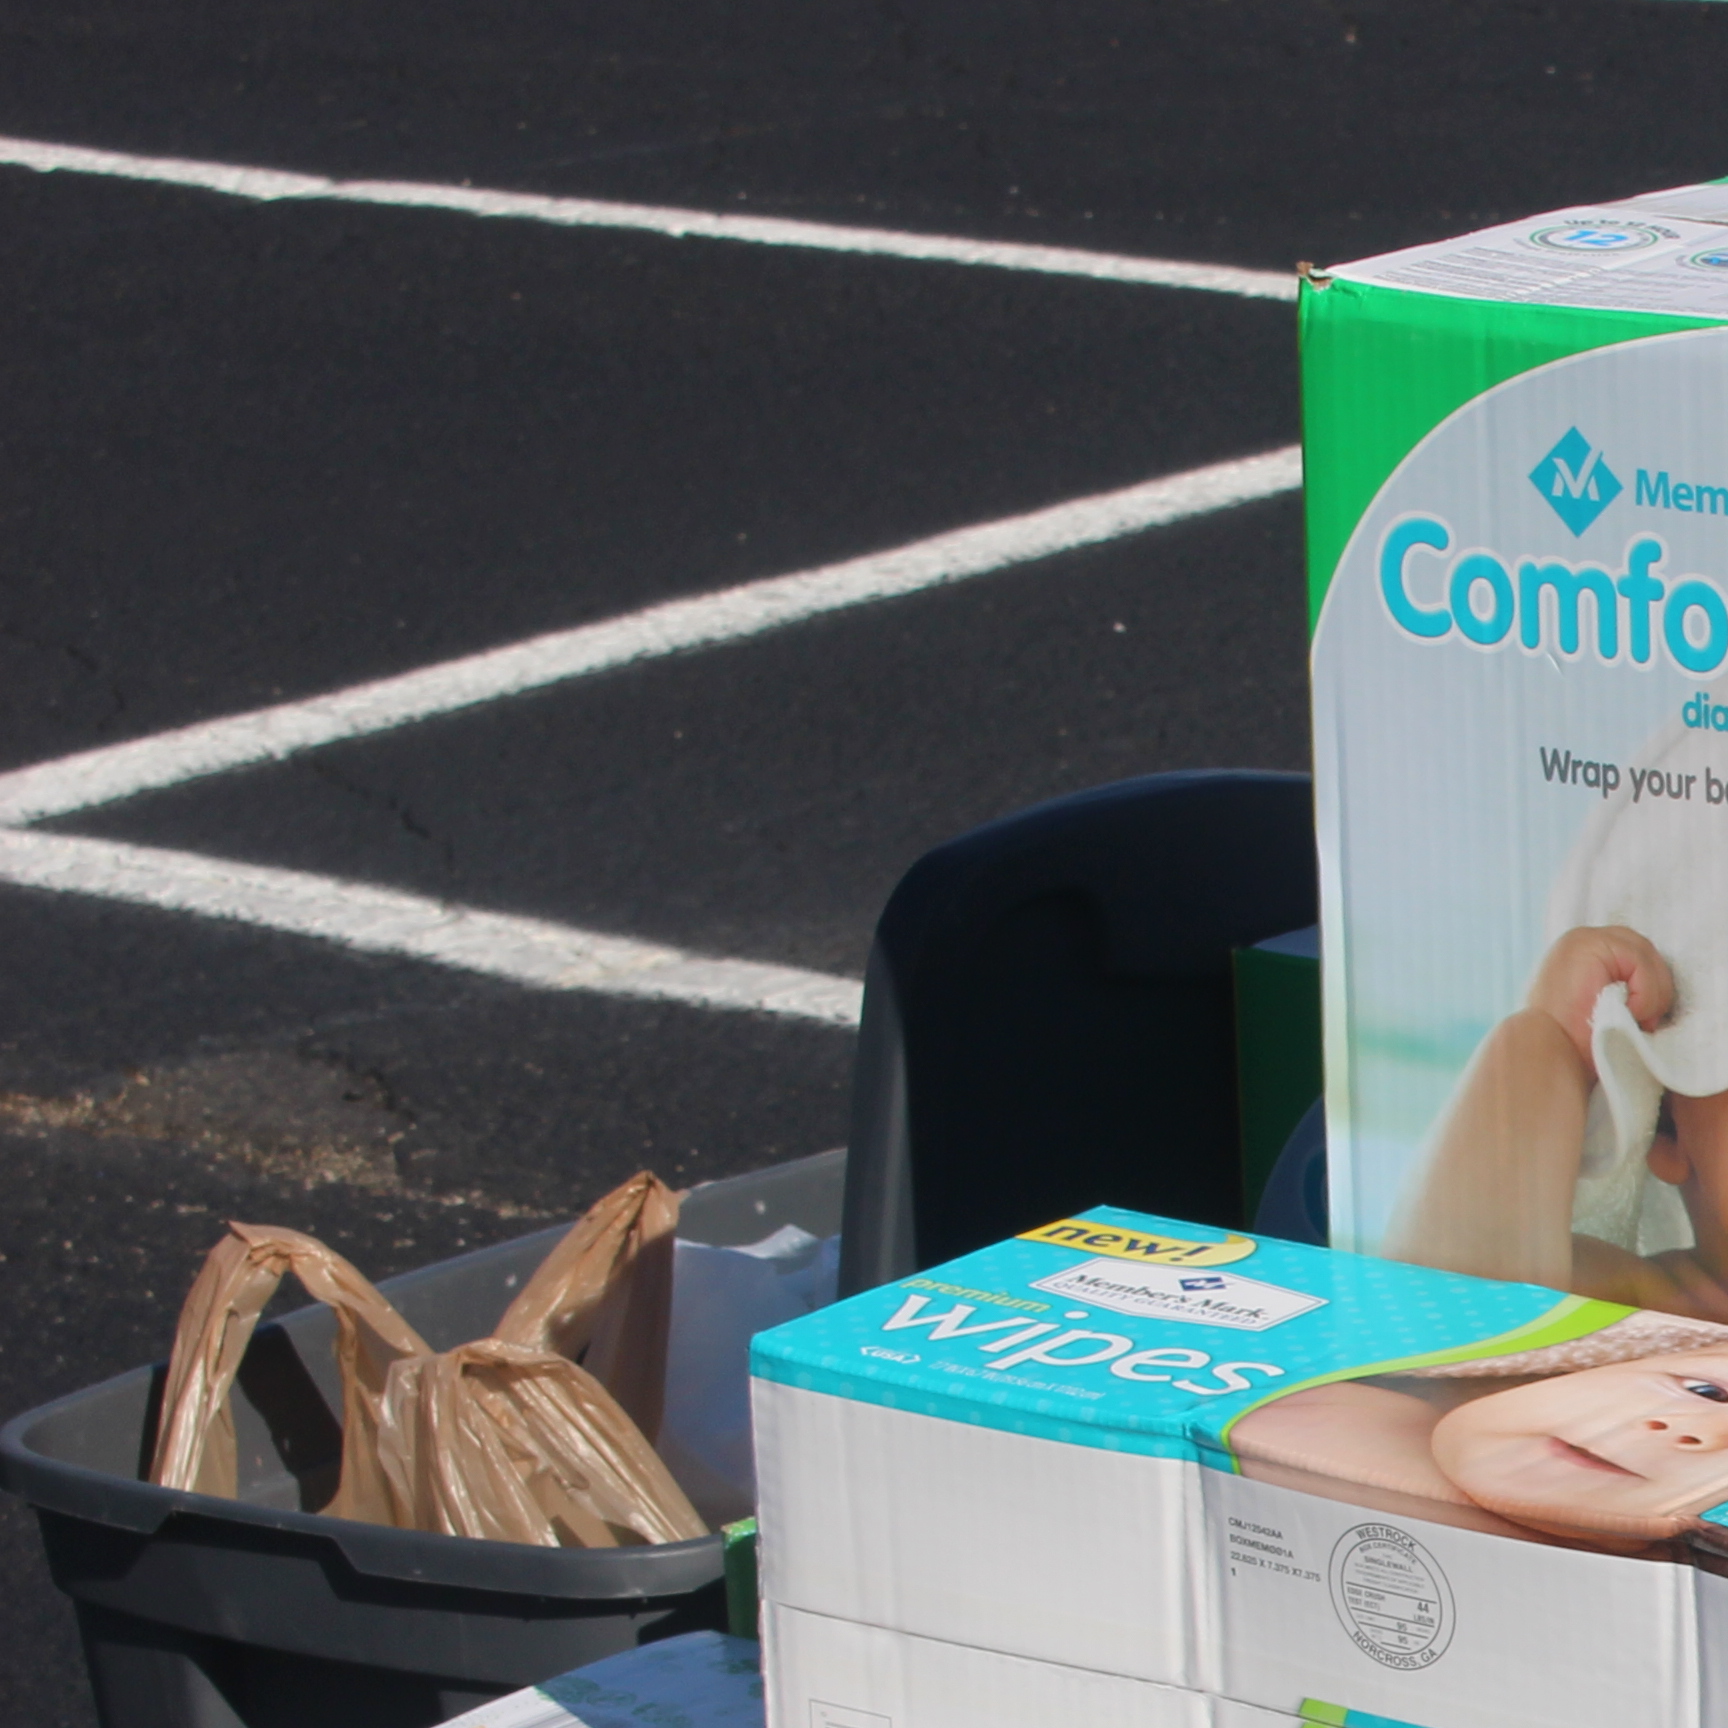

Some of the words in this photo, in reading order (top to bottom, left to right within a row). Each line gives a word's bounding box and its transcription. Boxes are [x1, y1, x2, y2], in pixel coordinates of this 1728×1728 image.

[1540, 748, 1620, 800] Wrap
[1629, 767, 1696, 805] your
[1044, 1225, 1210, 1262] new!
[902, 1279, 1051, 1312] premium
[882, 1294, 1285, 1395] wipes
[1356, 1527, 1416, 1551] WESTROCK
[1353, 1631, 1421, 1668] NORCROSS,
[1421, 1648, 1437, 1662] GA
